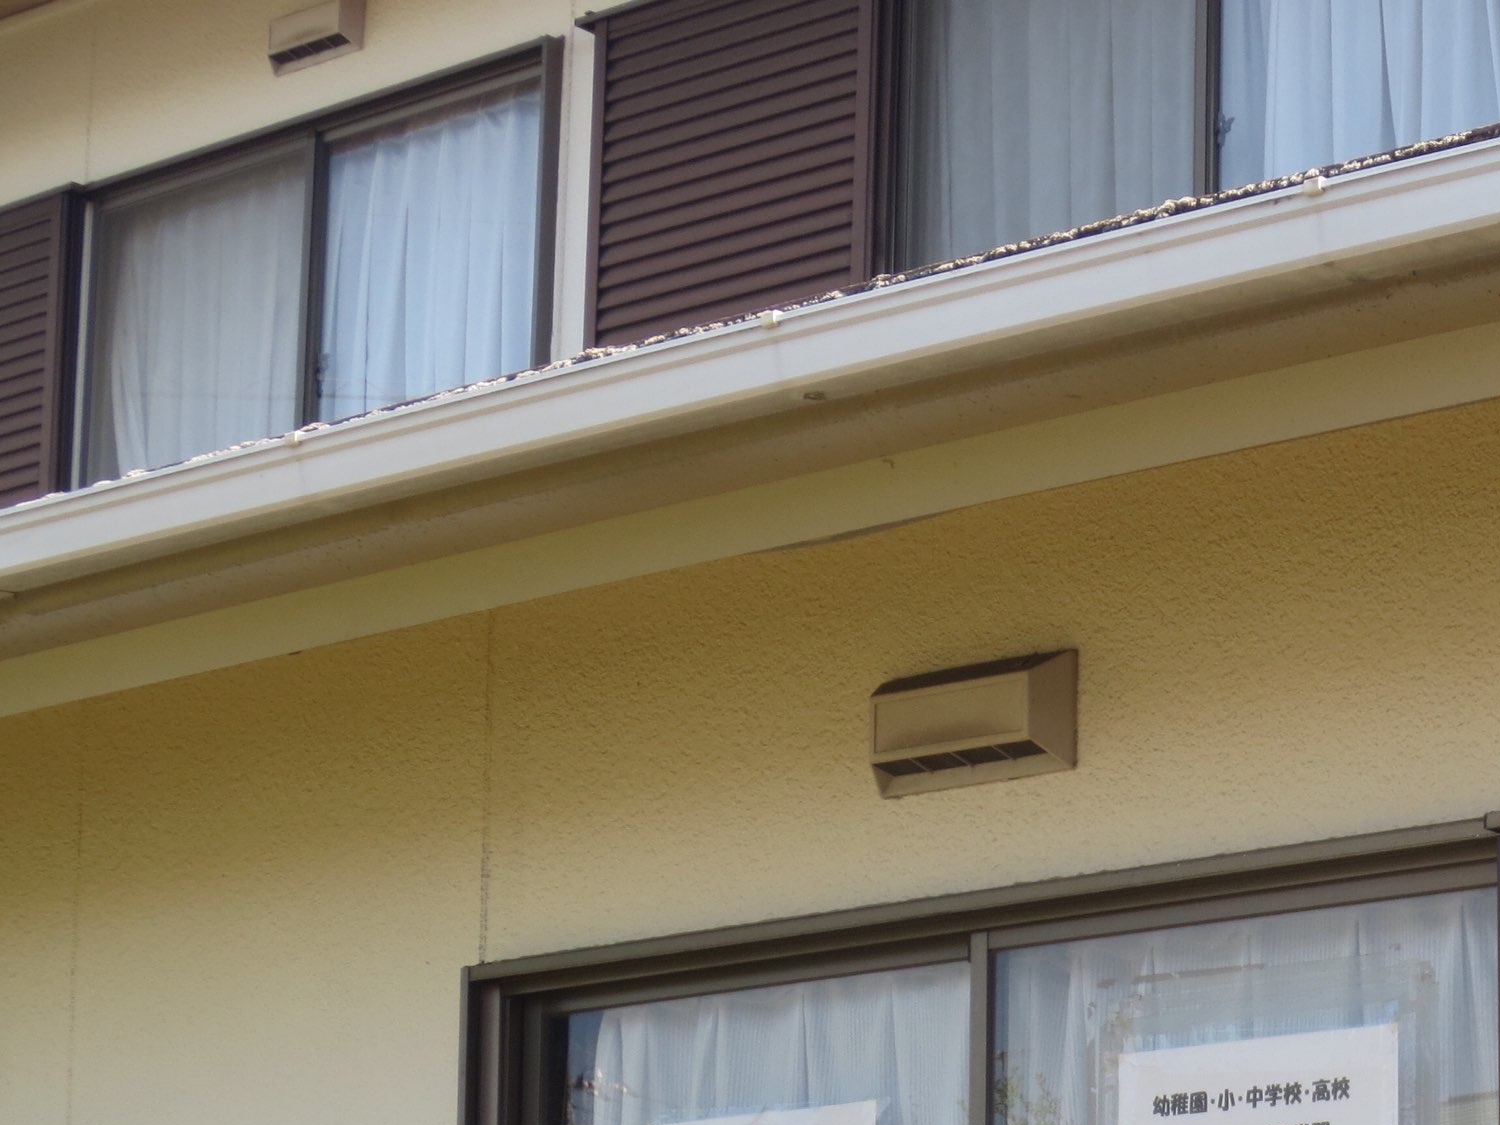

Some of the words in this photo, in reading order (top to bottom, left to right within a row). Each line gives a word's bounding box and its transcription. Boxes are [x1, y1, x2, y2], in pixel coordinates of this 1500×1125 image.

[1152, 1077, 1350, 1117] 幼稚園・小・中学校・高校
